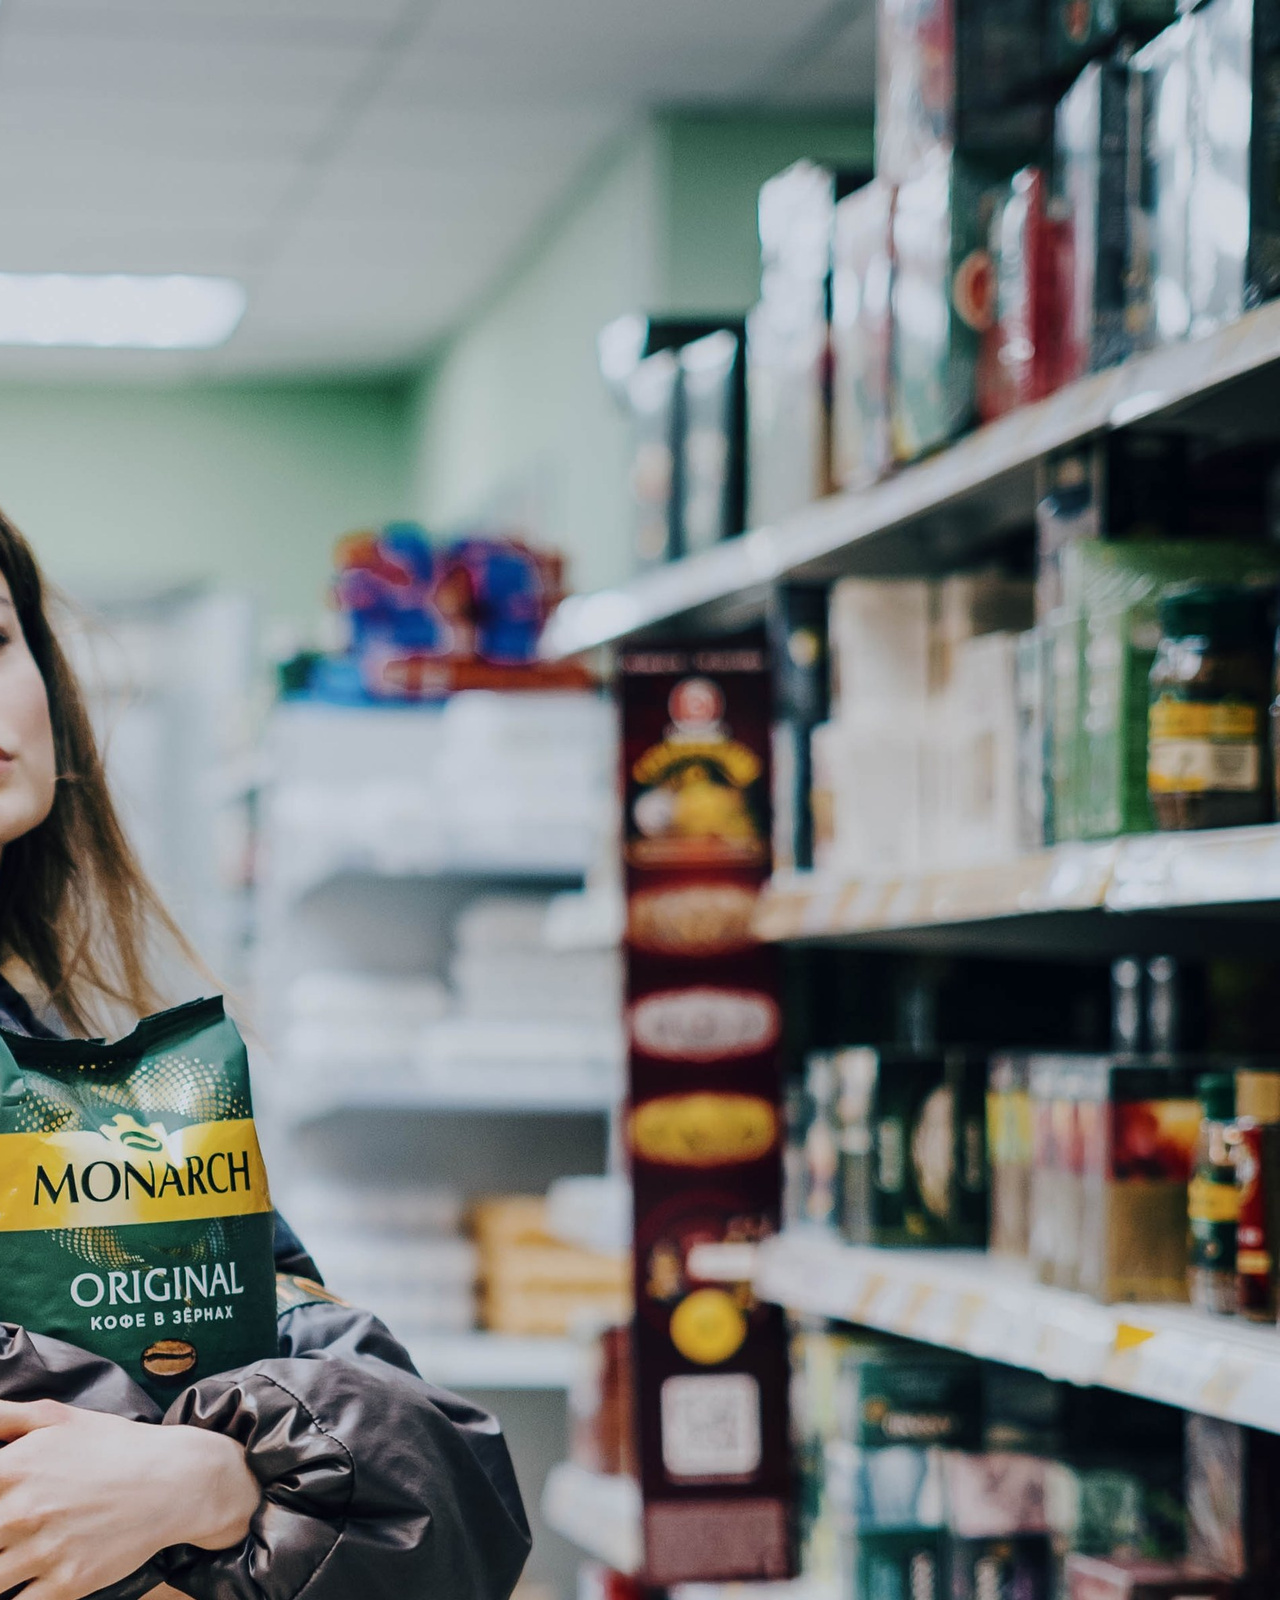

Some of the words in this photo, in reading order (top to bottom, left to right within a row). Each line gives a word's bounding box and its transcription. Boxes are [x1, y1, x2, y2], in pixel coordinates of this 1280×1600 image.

[33, 1150, 251, 1207] MONARCH
[70, 1262, 244, 1307] ORIGINAL
[90, 1313, 146, 1330] КОФЕ
[154, 1311, 165, 1326] В
[172, 1305, 233, 1325] ЗЁРНАХ
